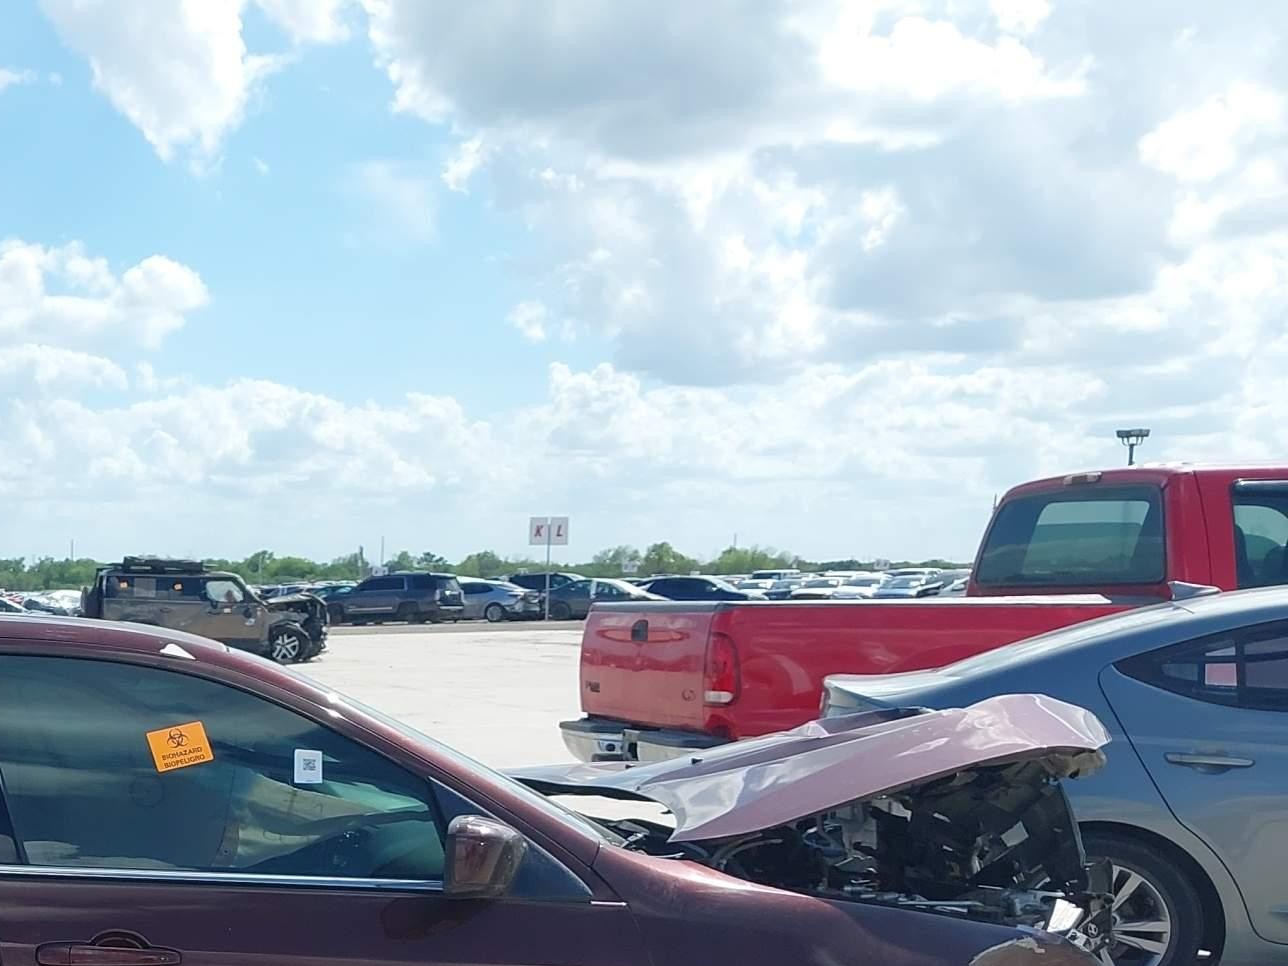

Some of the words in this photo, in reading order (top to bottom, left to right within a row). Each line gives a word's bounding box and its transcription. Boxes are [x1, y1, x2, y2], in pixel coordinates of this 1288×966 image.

[534, 524, 544, 537] K
[556, 524, 563, 537] L
[161, 746, 203, 761] BIOHAZARD
[164, 754, 206, 769] BIOPELIGRO
